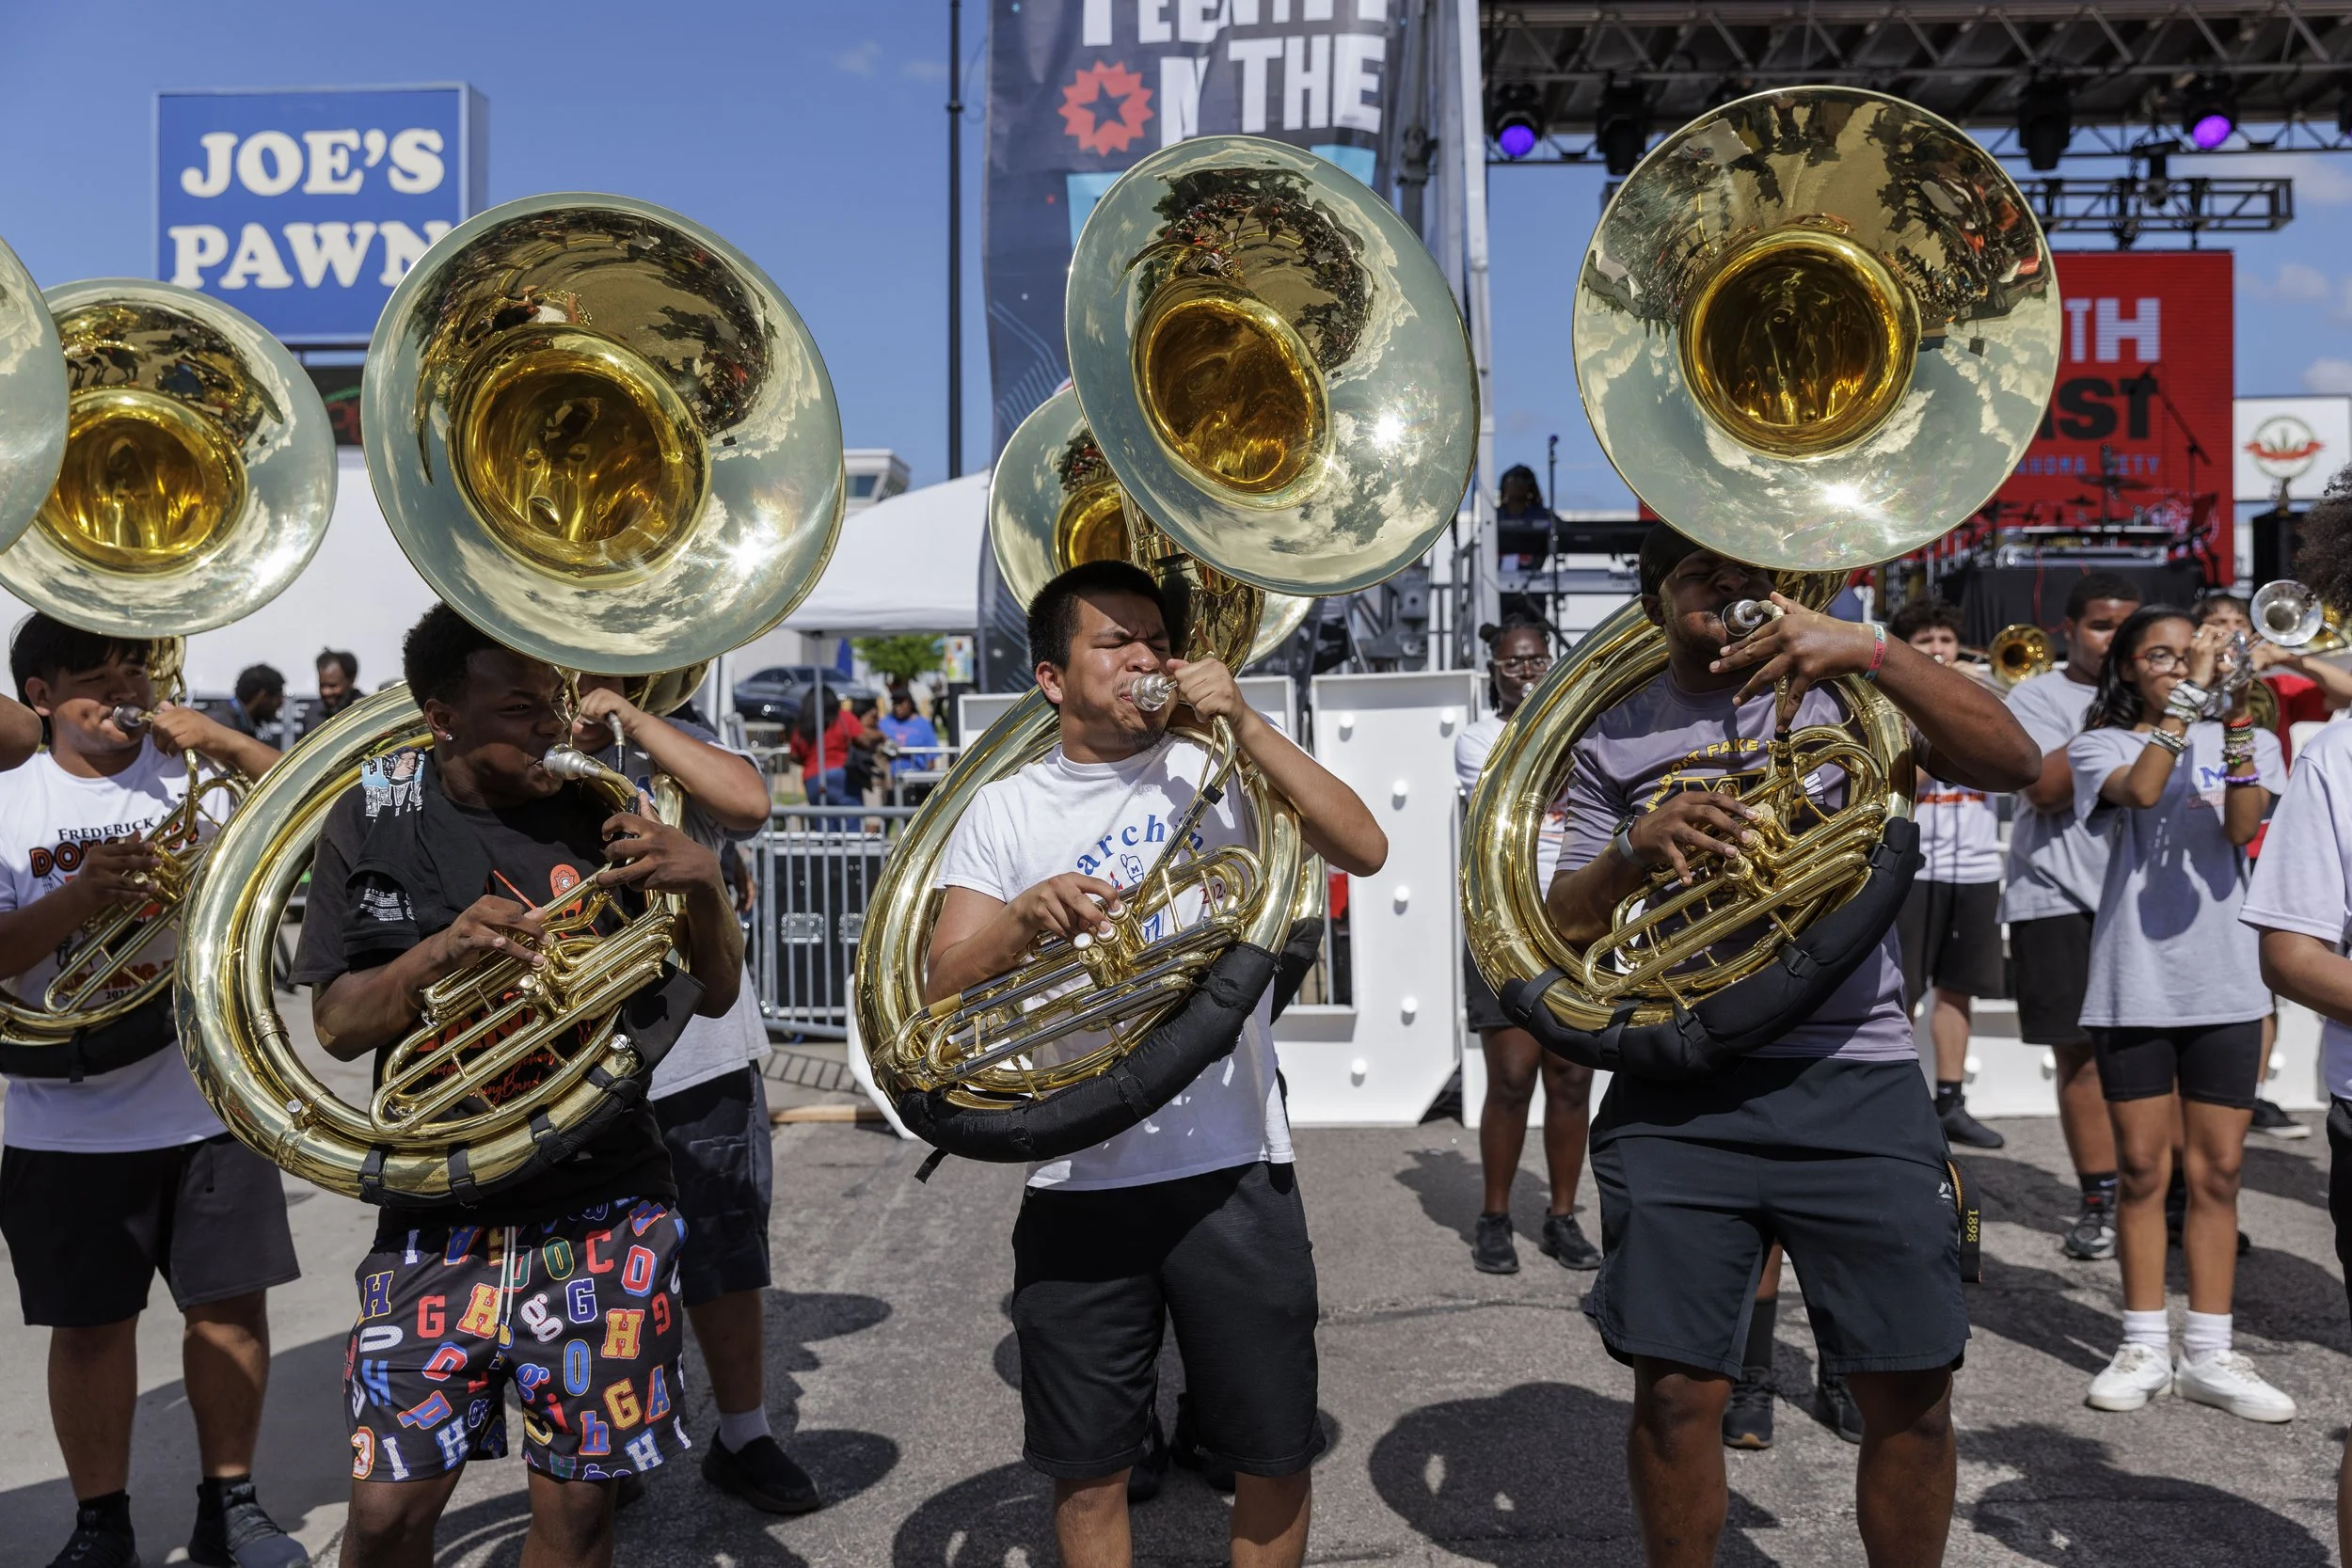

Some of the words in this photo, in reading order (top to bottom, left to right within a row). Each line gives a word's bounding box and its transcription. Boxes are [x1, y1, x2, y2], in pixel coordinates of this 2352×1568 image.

[1228, 33, 1387, 134] THE
[181, 128, 445, 198] JOE'S
[167, 220, 453, 290] PAWN
[1706, 738, 1759, 759] FAKE
[57, 817, 156, 841] FREDERICK
[1966, 1209, 1979, 1242] 1898
[418, 1295, 446, 1338] G
[565, 1277, 597, 1323] G
[601, 1308, 644, 1359] H
[603, 1377, 642, 1430] G
[579, 1410, 611, 1455] h
